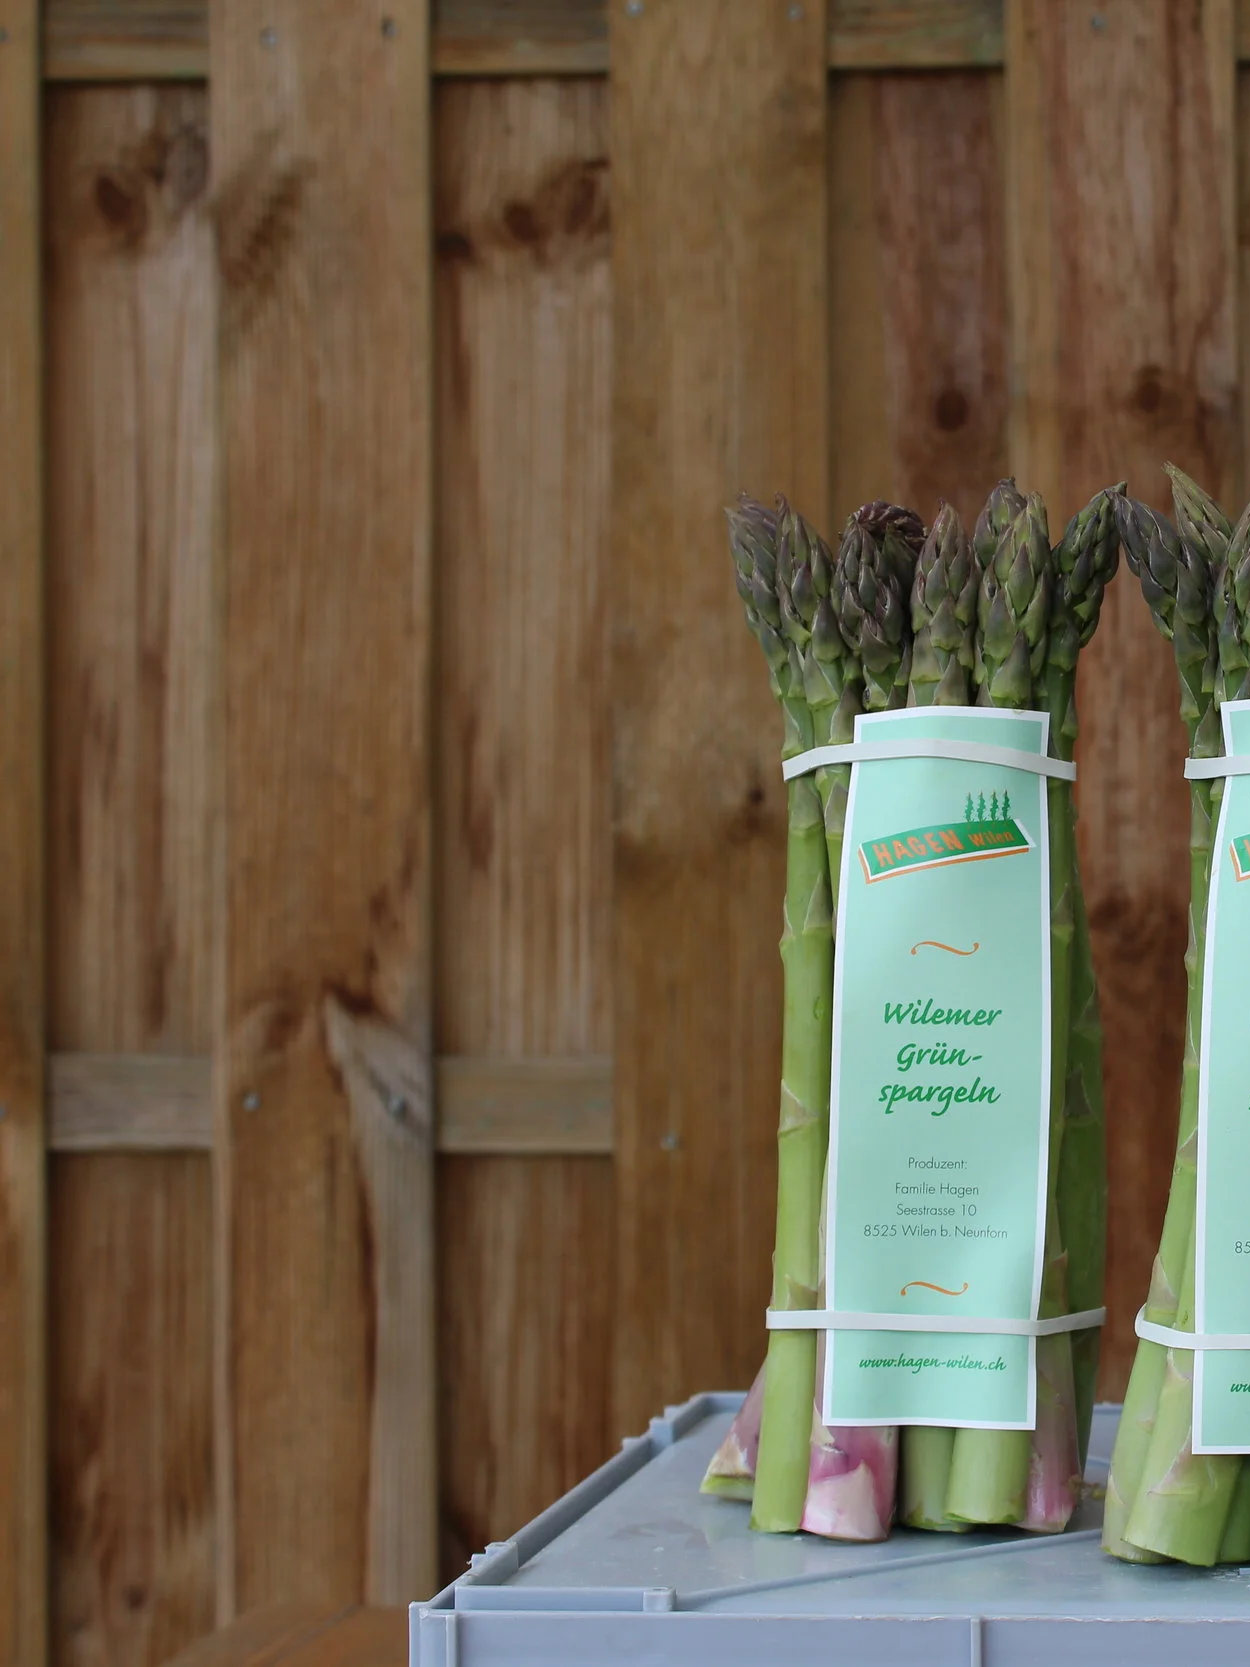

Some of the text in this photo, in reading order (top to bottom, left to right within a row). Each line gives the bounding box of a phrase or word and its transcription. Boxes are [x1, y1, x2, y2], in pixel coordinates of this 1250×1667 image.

[872, 829, 1016, 869] HAGEN Wilen
[883, 998, 1002, 1027] Wilemer
[896, 1042, 983, 1072] Grün-
[878, 1077, 1001, 1117] spargeln
[908, 1156, 968, 1170] Produzent:
[895, 1182, 979, 1199] Familie Hagen
[896, 1203, 977, 1217] Seestrasse 10
[863, 1224, 1008, 1240] 8525 Wilen b. Neunforn
[858, 1353, 1007, 1374] www.hagen-wilen.ch
